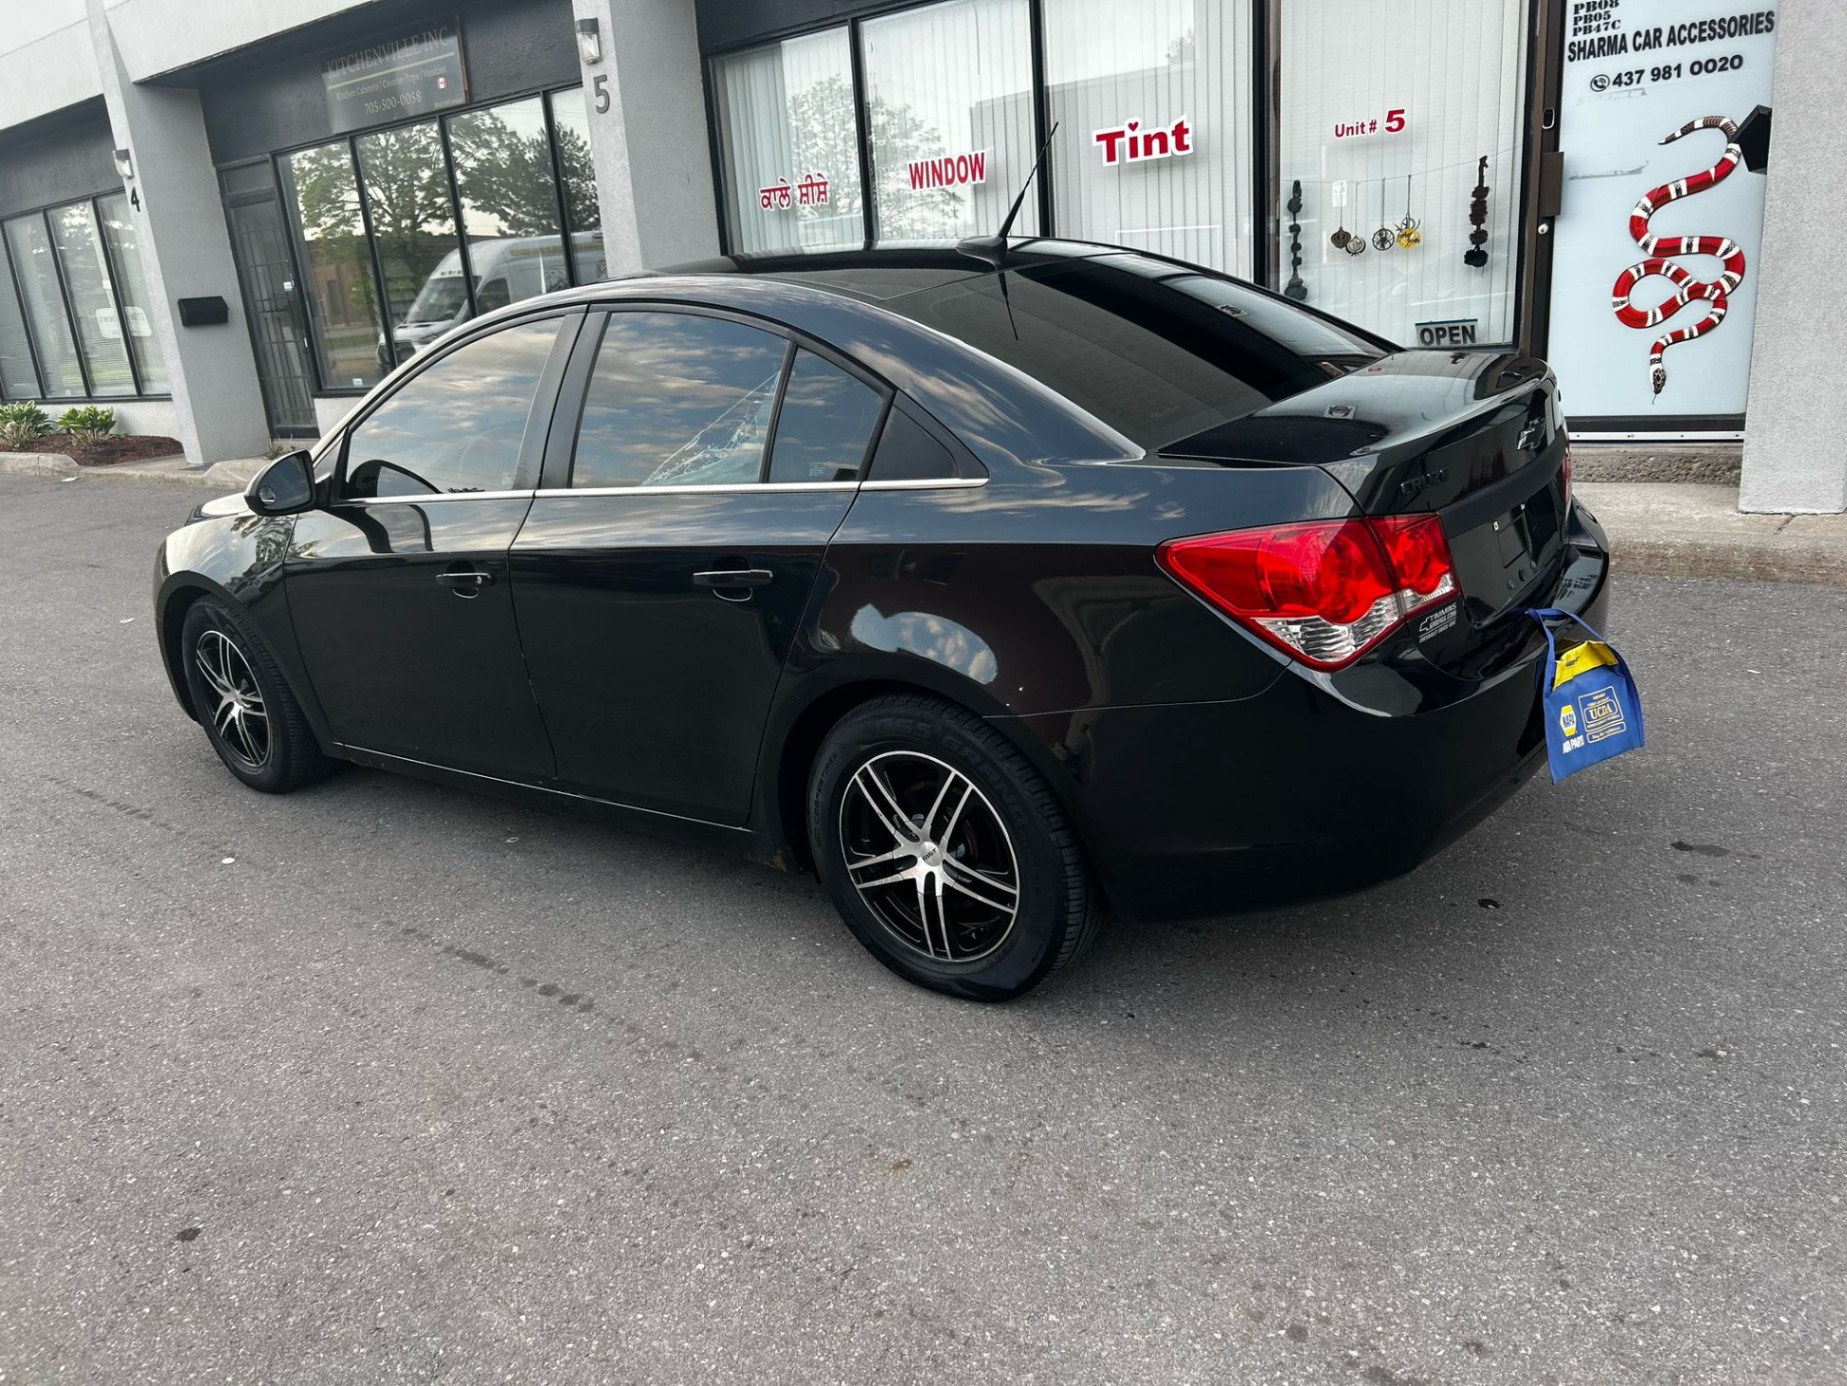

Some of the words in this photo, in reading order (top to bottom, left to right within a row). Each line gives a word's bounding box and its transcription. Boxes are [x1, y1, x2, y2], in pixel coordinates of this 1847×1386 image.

[1572, 19, 1621, 37] PB47C
[1573, 10, 1612, 26] PB05
[1567, 33, 1628, 62] SHARMA
[1633, 27, 1663, 52] CAR
[1666, 10, 1775, 48] ACCESSORIES
[327, 35, 420, 79] KITCHENVILLE
[422, 26, 453, 51] INC.
[1612, 69, 1645, 88] 437
[1650, 63, 1682, 82] 981
[1689, 54, 1744, 76] 0020
[593, 74, 610, 114] 5
[1334, 121, 1366, 138] Unit
[1368, 119, 1378, 134] #
[1384, 108, 1406, 133] 5
[1095, 118, 1191, 163] Tint
[908, 152, 986, 190] WINDOW
[130, 186, 140, 212] 4
[760, 178, 791, 209] ਕਾਲੇ
[1419, 324, 1477, 346] OPEN
